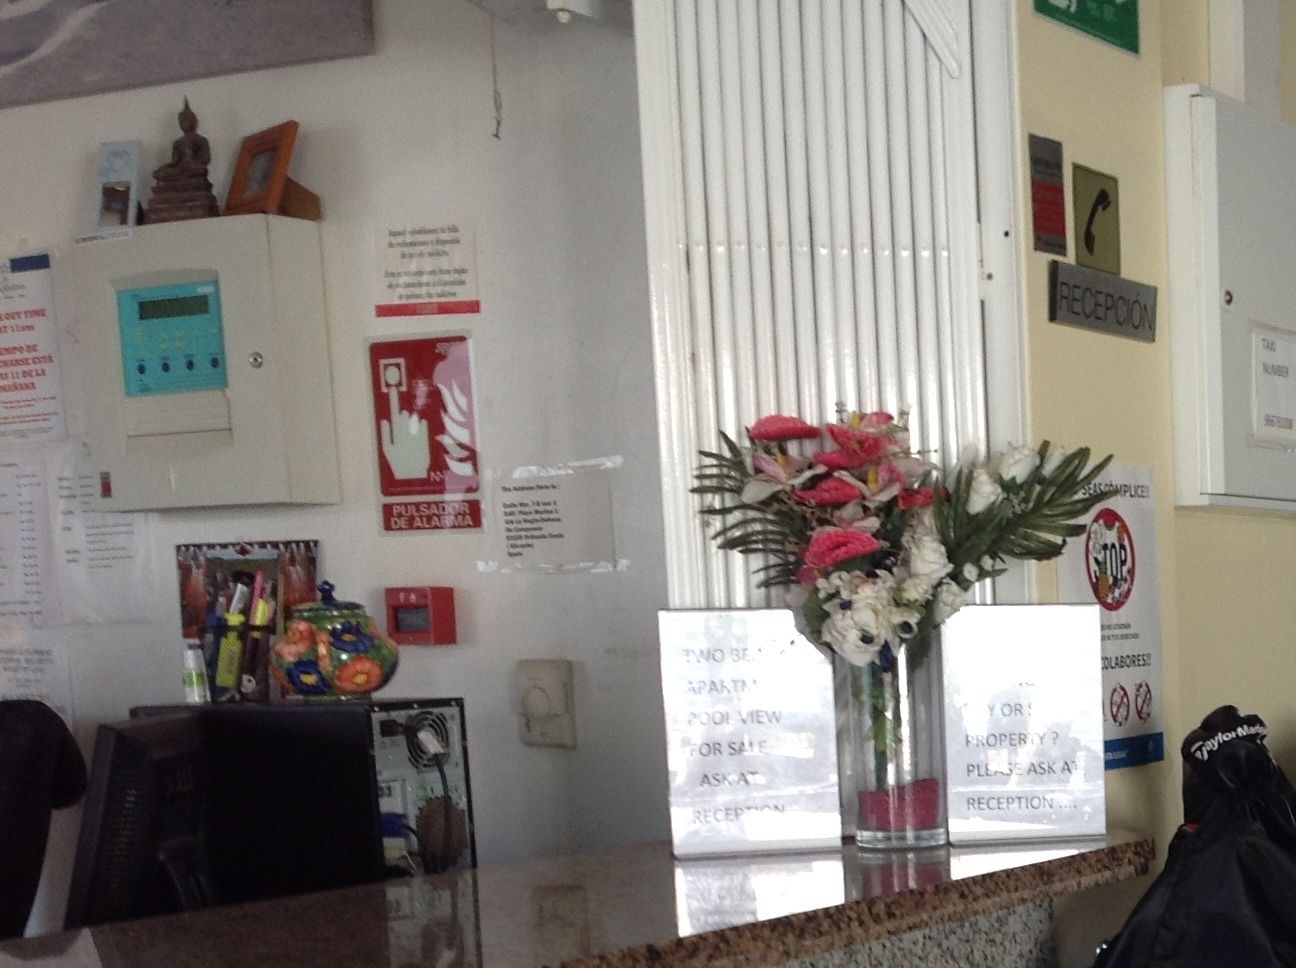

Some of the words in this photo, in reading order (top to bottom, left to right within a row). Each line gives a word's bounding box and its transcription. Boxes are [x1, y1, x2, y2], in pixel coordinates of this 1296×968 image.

[1060, 282, 1153, 331] RECEPCIÓN
[393, 502, 470, 517] PULSADOR
[390, 517, 409, 529] DE
[413, 515, 473, 529] ALARMA
[737, 709, 783, 725] VIEW
[1001, 703, 1024, 717] OR
[966, 732, 1046, 748] PROPERTY
[689, 742, 722, 757] FOR
[728, 740, 768, 756] SALE
[966, 761, 1023, 777] PLEASE
[1027, 760, 1055, 776] ASK
[1061, 760, 1079, 775] AT
[701, 772, 733, 788] ASK
[967, 796, 1054, 811] RECEPTION
